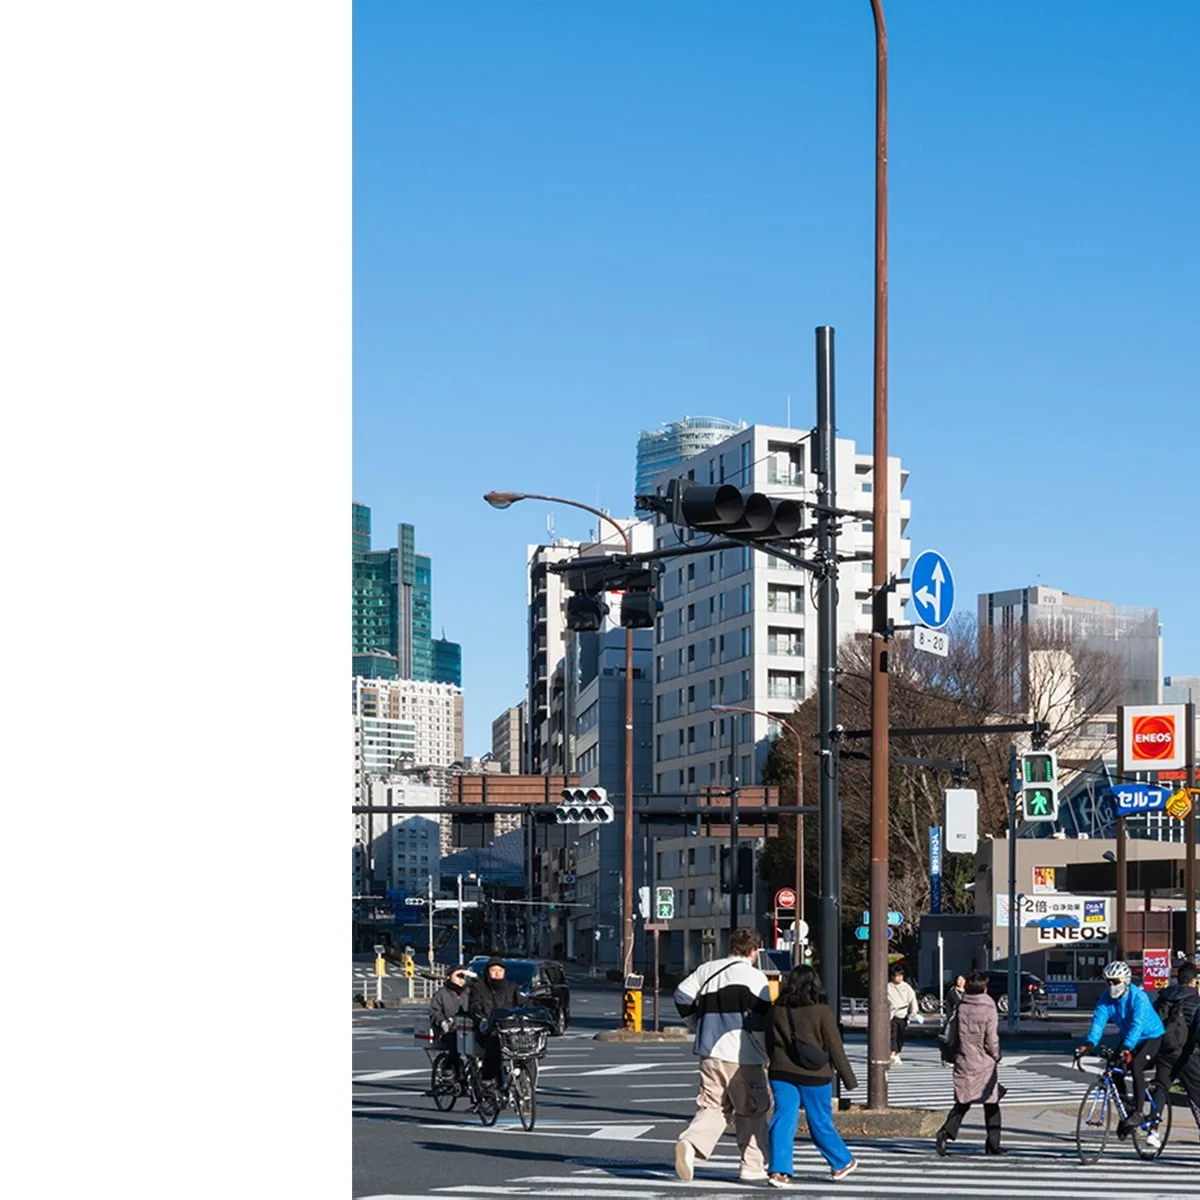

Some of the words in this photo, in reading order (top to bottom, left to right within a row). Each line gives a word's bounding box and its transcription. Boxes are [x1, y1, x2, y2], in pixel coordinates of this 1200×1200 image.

[1135, 732, 1172, 743] ENEOS
[1117, 790, 1162, 808] セルフ
[1040, 926, 1108, 940] ENEOS
